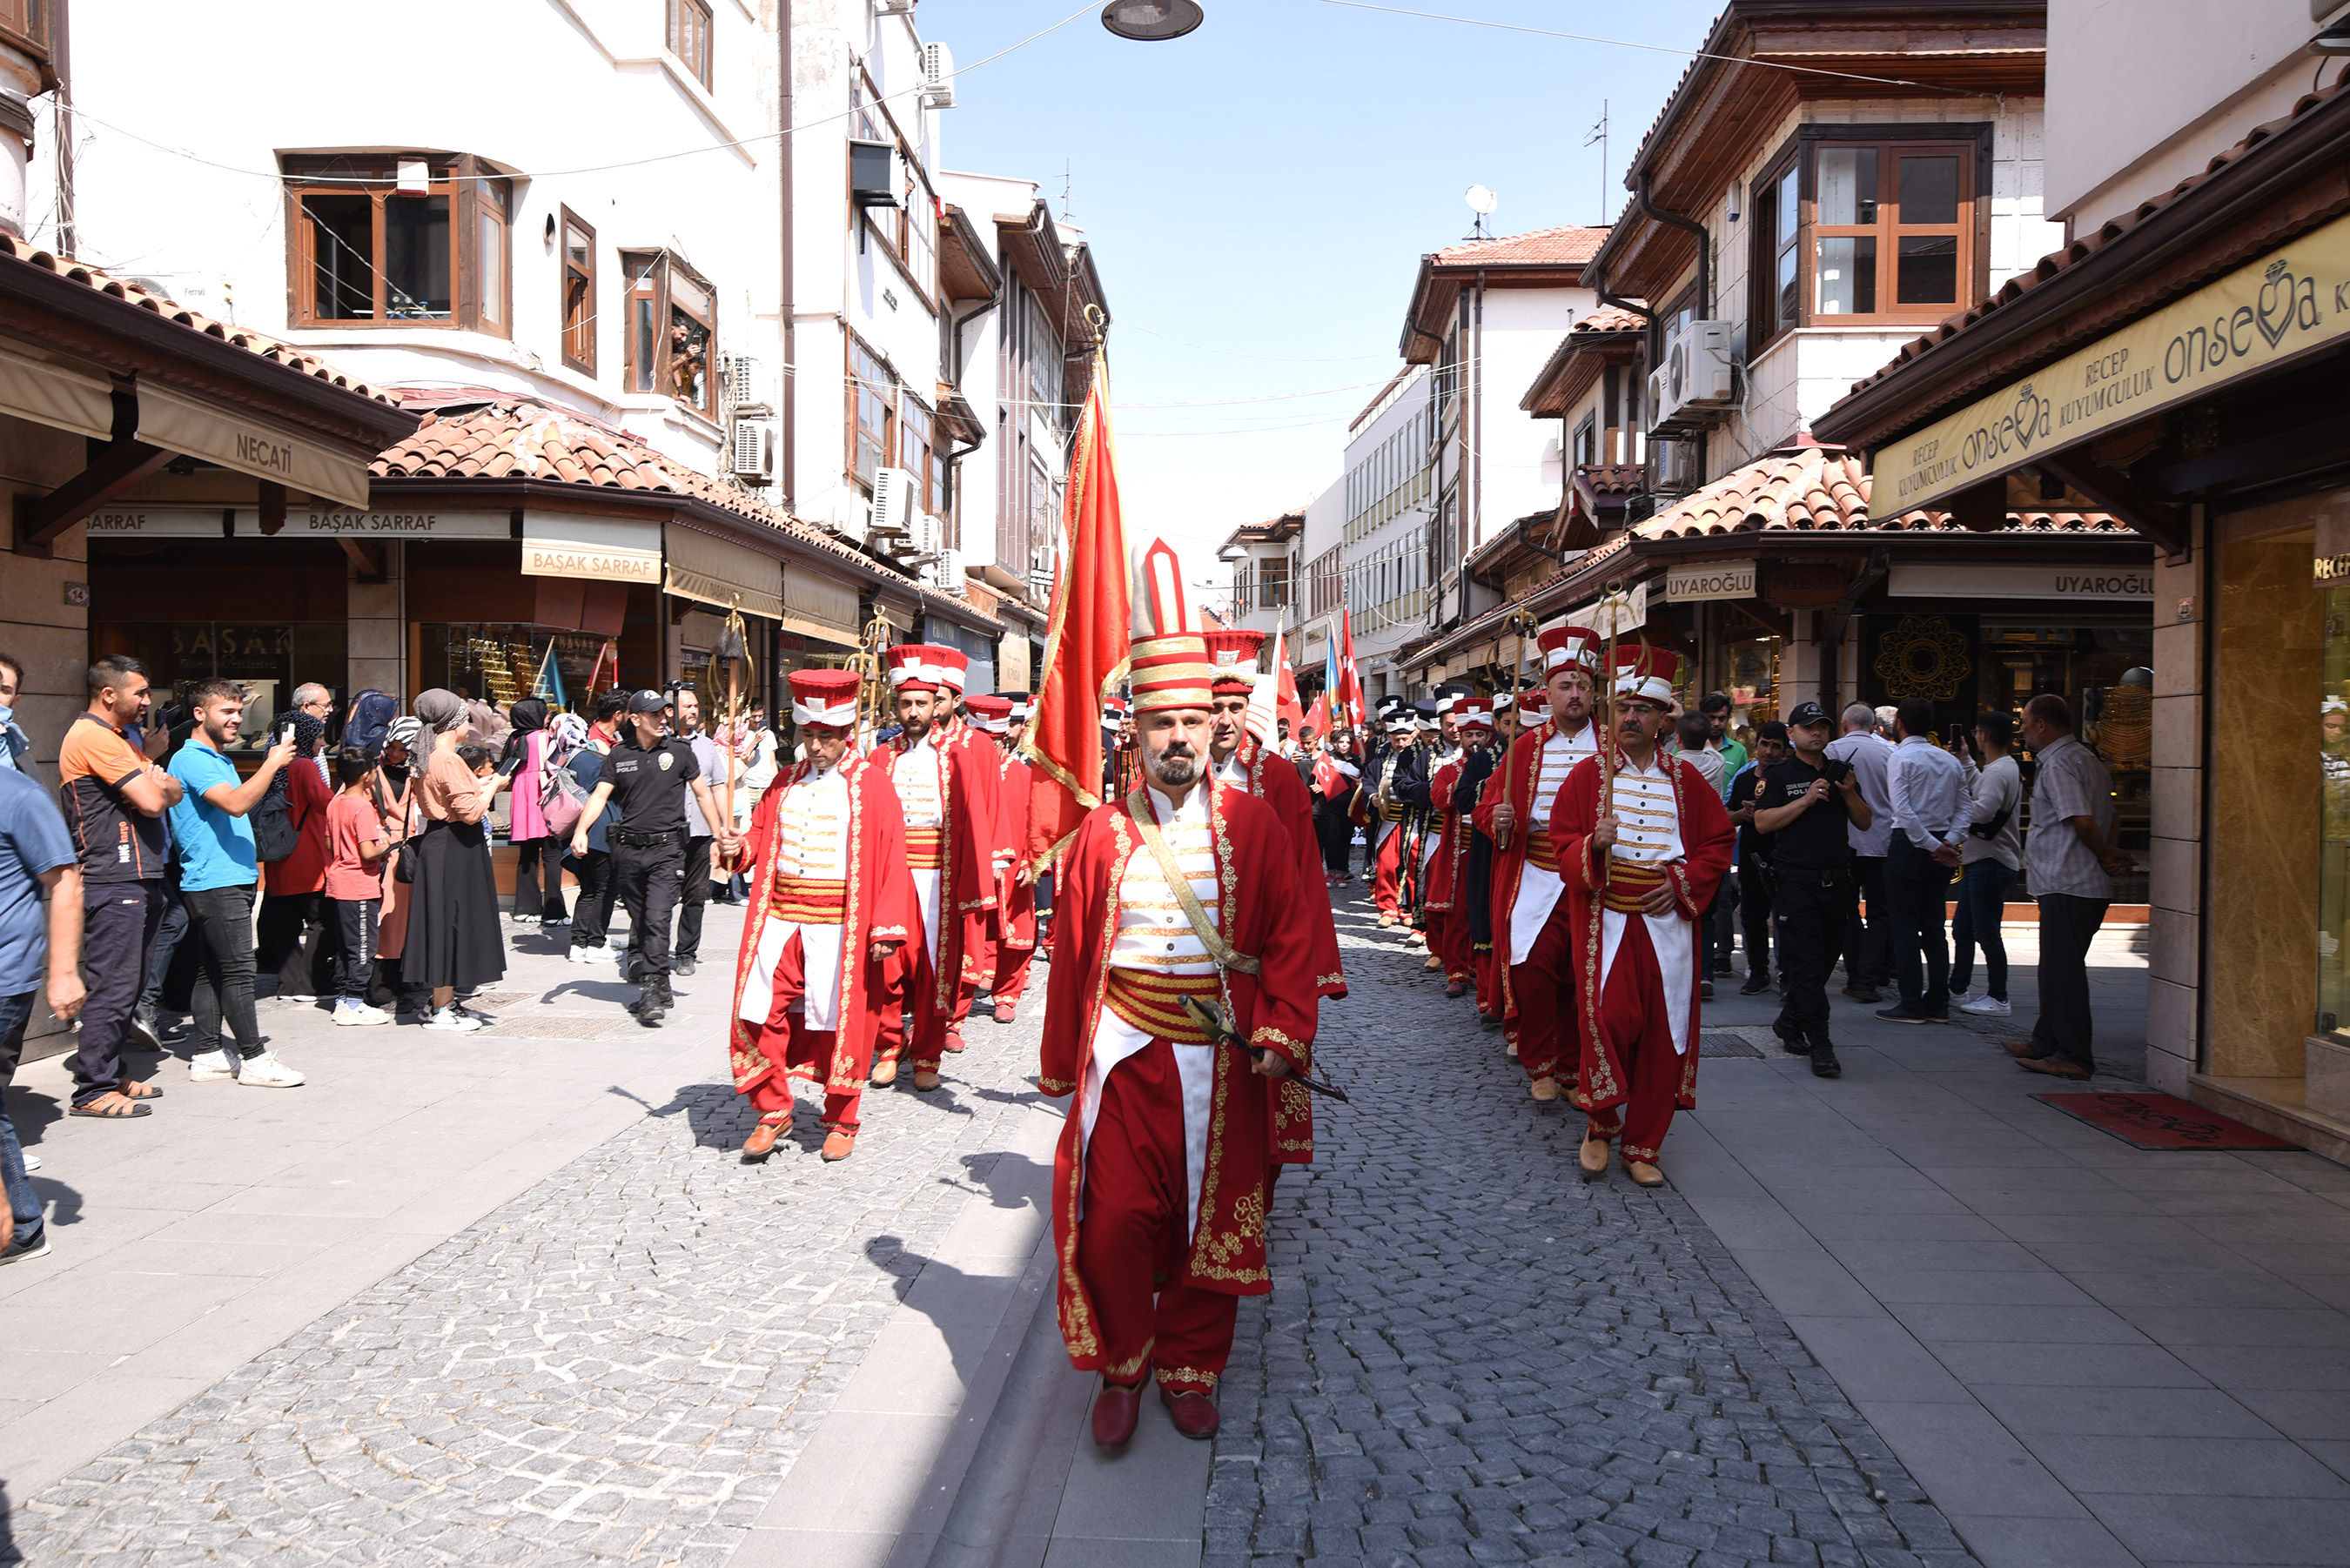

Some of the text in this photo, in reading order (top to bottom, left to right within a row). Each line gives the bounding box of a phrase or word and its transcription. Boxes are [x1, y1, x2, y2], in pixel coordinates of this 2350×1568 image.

[2085, 348, 2129, 388] RECEP
[2059, 366, 2155, 428] KUYUMCULUK
[236, 432, 292, 473] NECATİ
[1912, 439, 1940, 467] RECEP
[1897, 454, 1958, 498] KUYUMCULUK
[309, 513, 436, 533] BAŞAK SARRAF
[533, 553, 651, 576] BAŞAK SARRAF
[72, 589, 84, 601] 14
[1669, 571, 1753, 596] UYAROĞLU
[118, 843, 131, 863] MNG
